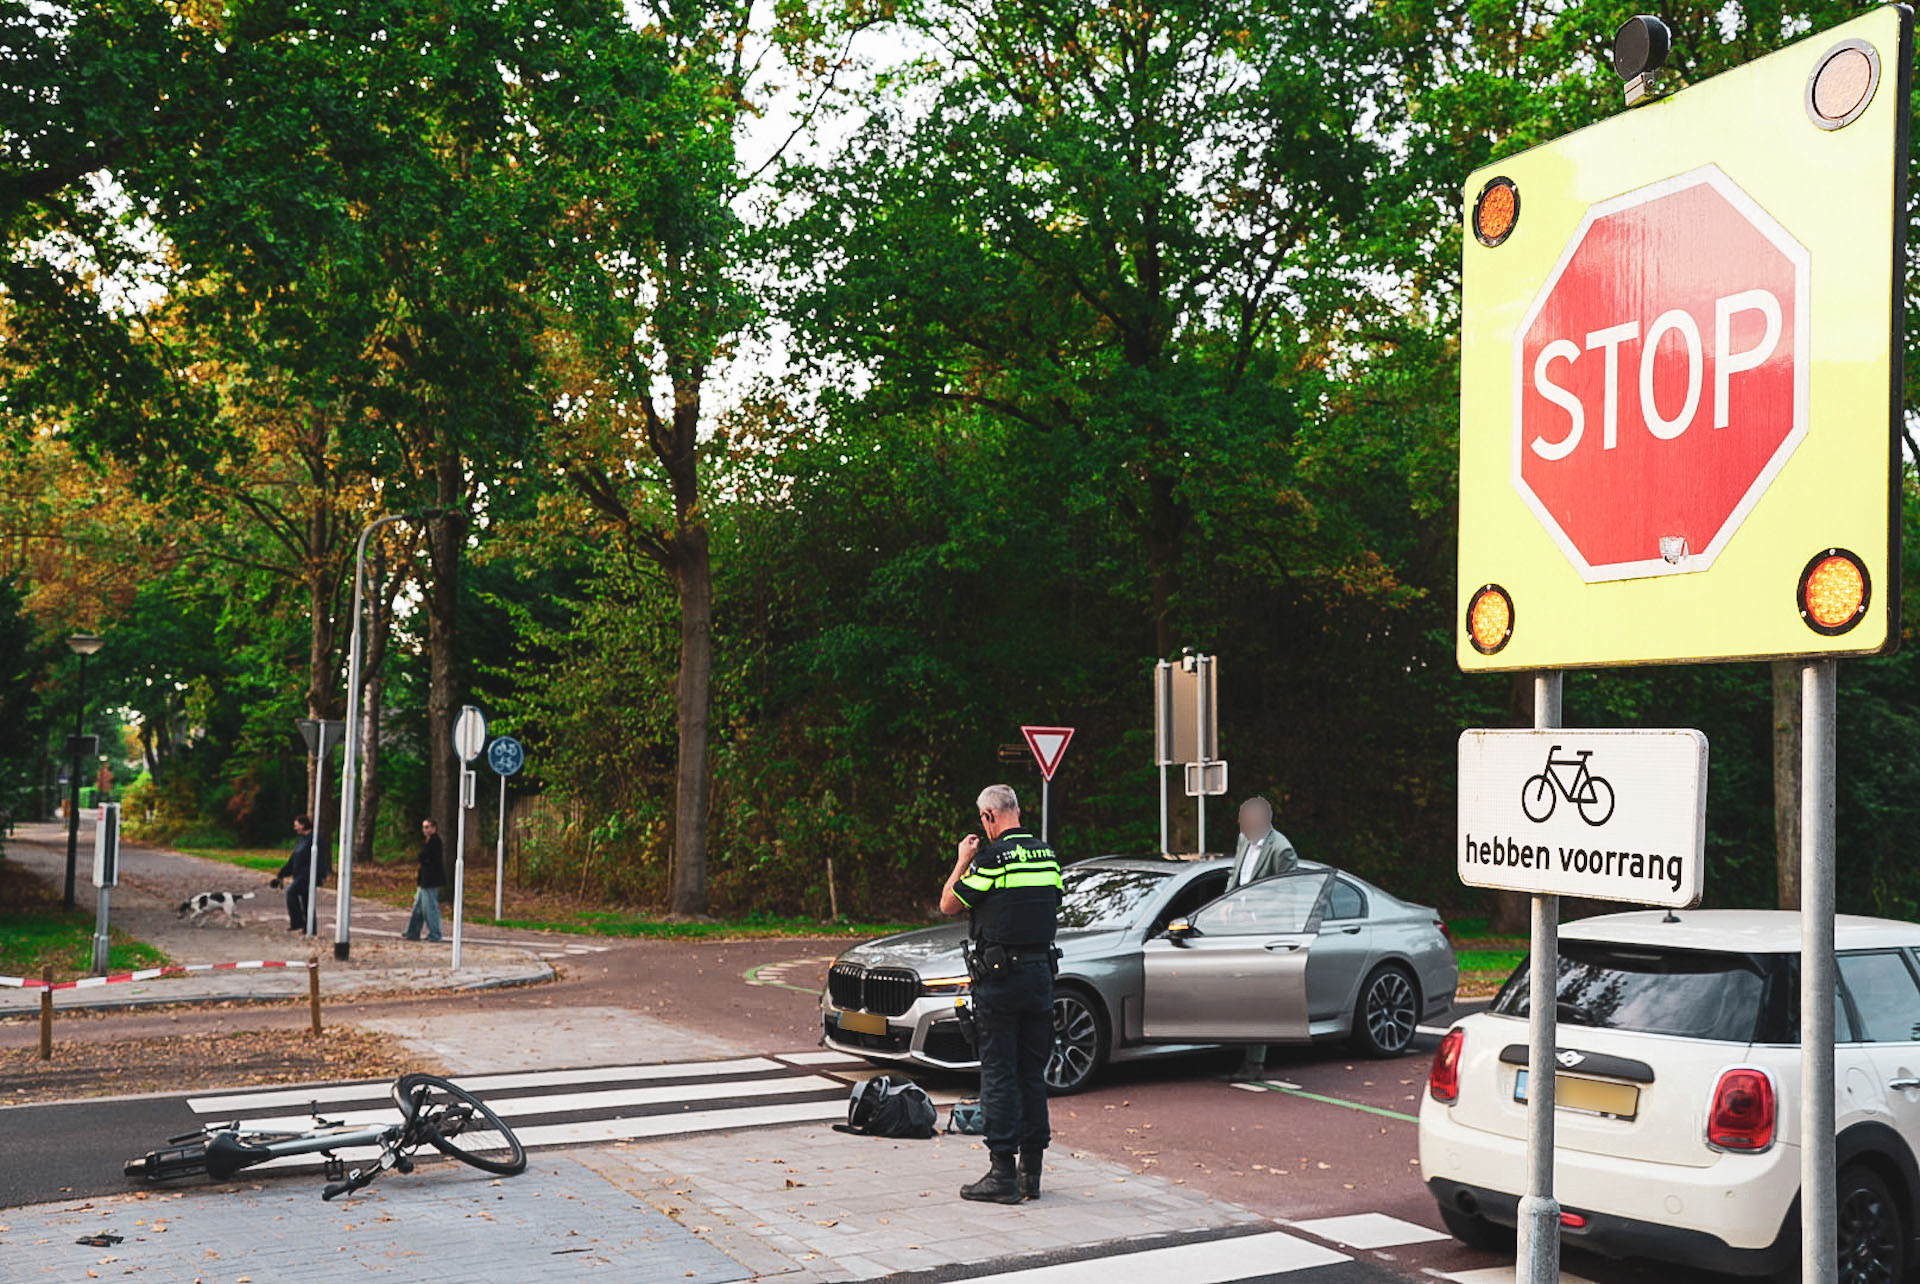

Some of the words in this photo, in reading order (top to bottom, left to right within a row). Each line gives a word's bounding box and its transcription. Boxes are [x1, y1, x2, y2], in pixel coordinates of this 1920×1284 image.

[1531, 289, 1783, 461] STOP
[1010, 845, 1053, 862] POLITIE
[1466, 833, 1550, 870] hebben
[1559, 847, 1683, 893] voorrang
